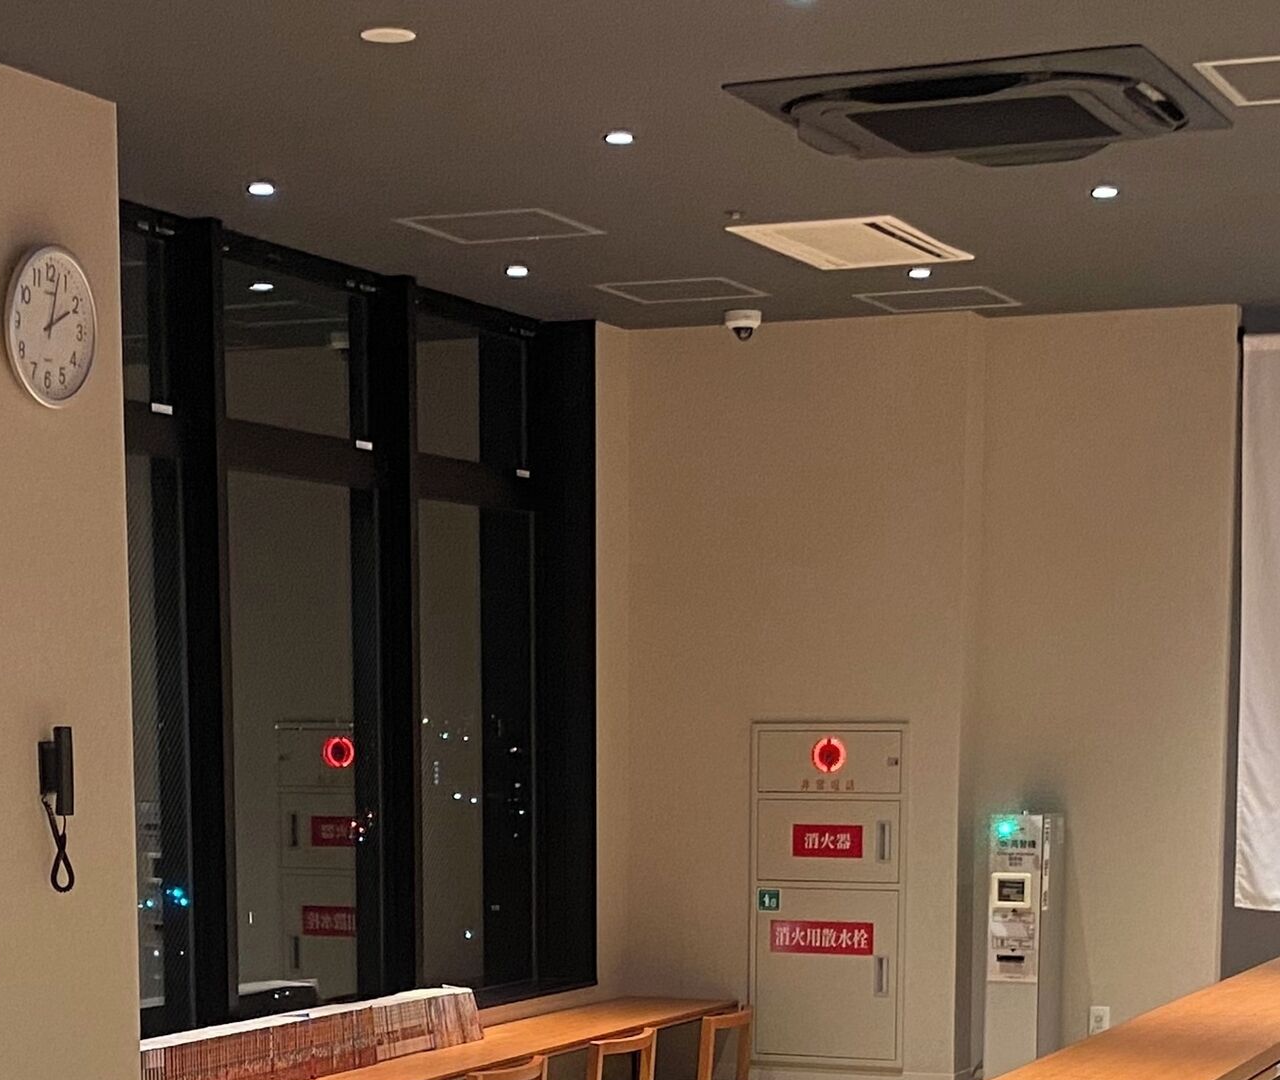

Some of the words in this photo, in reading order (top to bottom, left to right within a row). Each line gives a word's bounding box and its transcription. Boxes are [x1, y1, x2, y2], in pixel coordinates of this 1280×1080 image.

[32, 267, 41, 288] 11
[45, 262, 56, 283] 12
[63, 274, 68, 293] 1
[20, 285, 32, 305] 10
[72, 296, 80, 314] 2
[15, 311, 21, 329] 9
[76, 323, 84, 342] 3
[19, 341, 26, 359] 8
[70, 351, 77, 368] 4
[30, 361, 38, 380] 7
[44, 370, 51, 389] 6
[58, 367, 66, 385] 5
[804, 832, 851, 850] 消火器
[775, 926, 868, 949] 消火用散水栓
